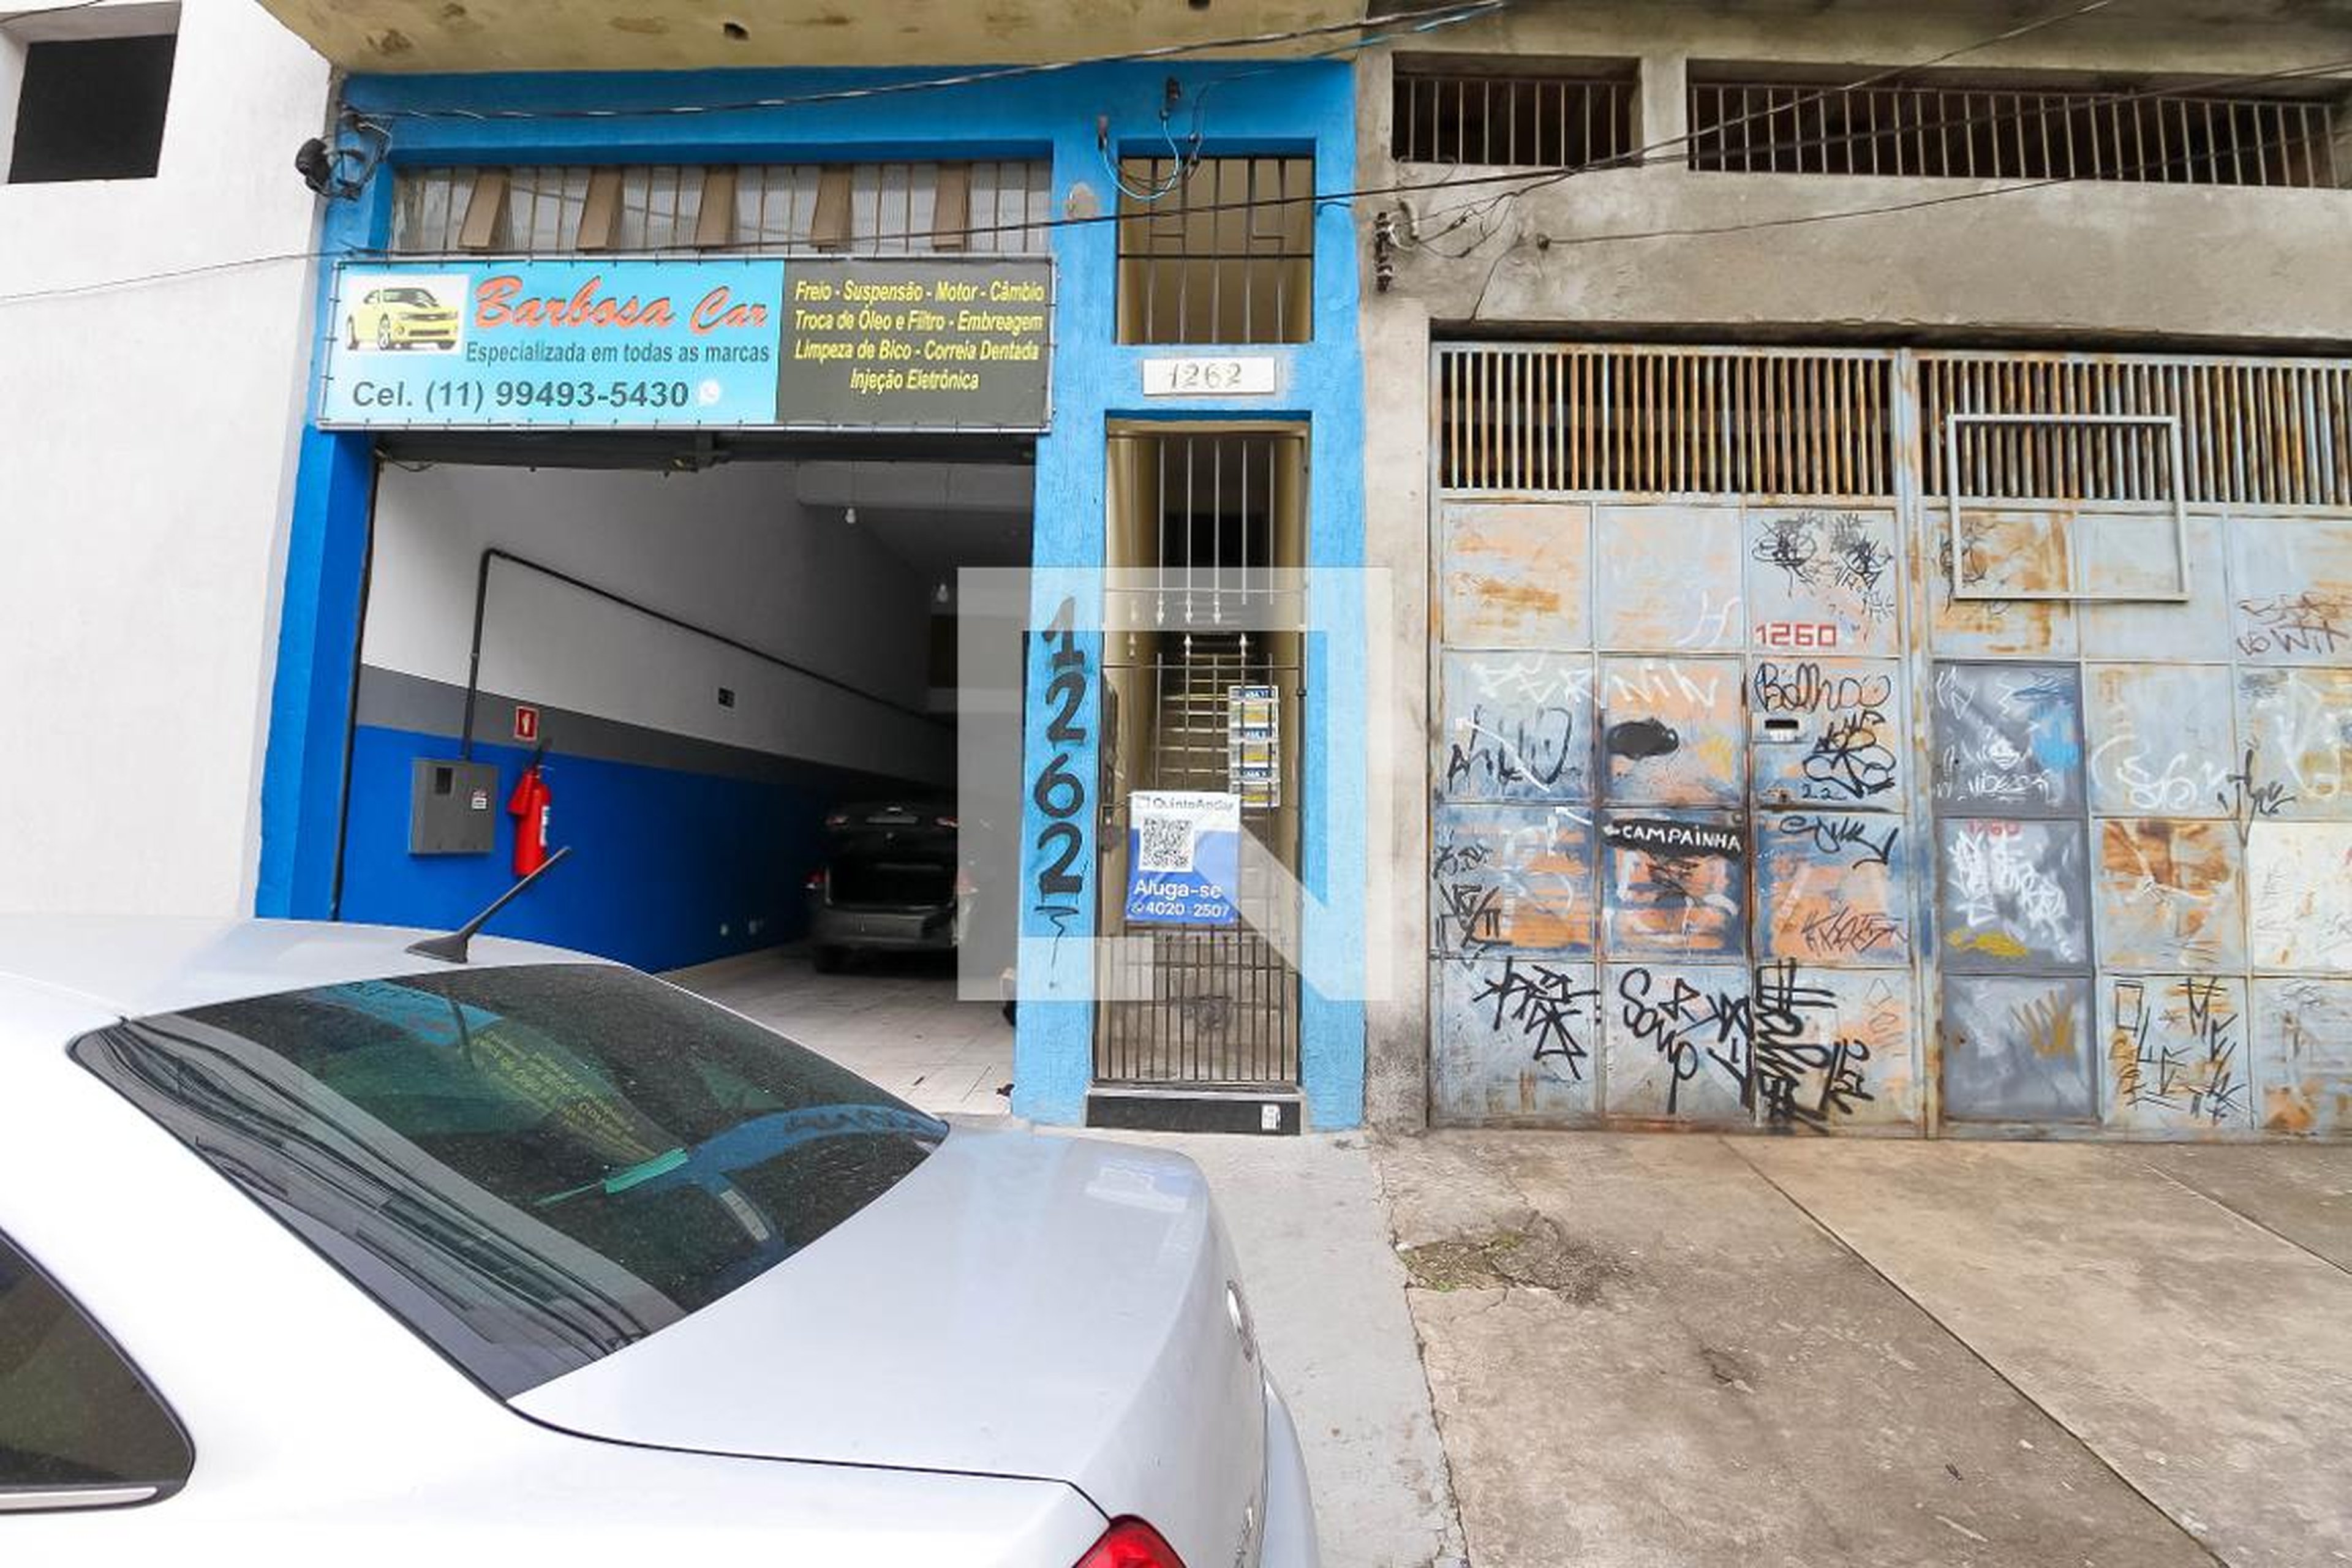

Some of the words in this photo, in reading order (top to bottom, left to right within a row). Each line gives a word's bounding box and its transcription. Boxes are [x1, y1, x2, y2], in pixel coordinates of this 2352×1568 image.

[475, 275, 676, 328] Barbosa
[690, 285, 767, 335] Car
[795, 280, 832, 301] Freio
[843, 279, 924, 306] Suspensão
[935, 281, 979, 302] Motor
[990, 280, 1044, 302] Câmbio
[796, 309, 834, 330] Troca
[837, 309, 854, 330] de
[859, 304, 892, 331] Óleo
[895, 314, 905, 331] e
[908, 309, 945, 331] Filtro
[957, 309, 1044, 336] Embreagem
[466, 341, 586, 367] Especializada
[591, 347, 616, 363] em
[624, 342, 673, 363] todas
[677, 347, 699, 363] as
[704, 346, 770, 363] marcas
[794, 339, 854, 364] Limpeza
[858, 338, 875, 359] de
[878, 339, 912, 360] Bico
[924, 339, 978, 360] Correia
[979, 339, 1039, 361] Dentada
[850, 368, 904, 395] Injeção
[907, 369, 979, 390] Eletrônica
[1169, 361, 1243, 390] 1262
[352, 380, 413, 407] Cel.
[426, 380, 484, 413] (11)
[495, 380, 690, 408] 99493-5430
[1754, 622, 1838, 647] 1260
[1134, 878, 1223, 901] Aluga-se
[1146, 901, 1185, 916] 4020
